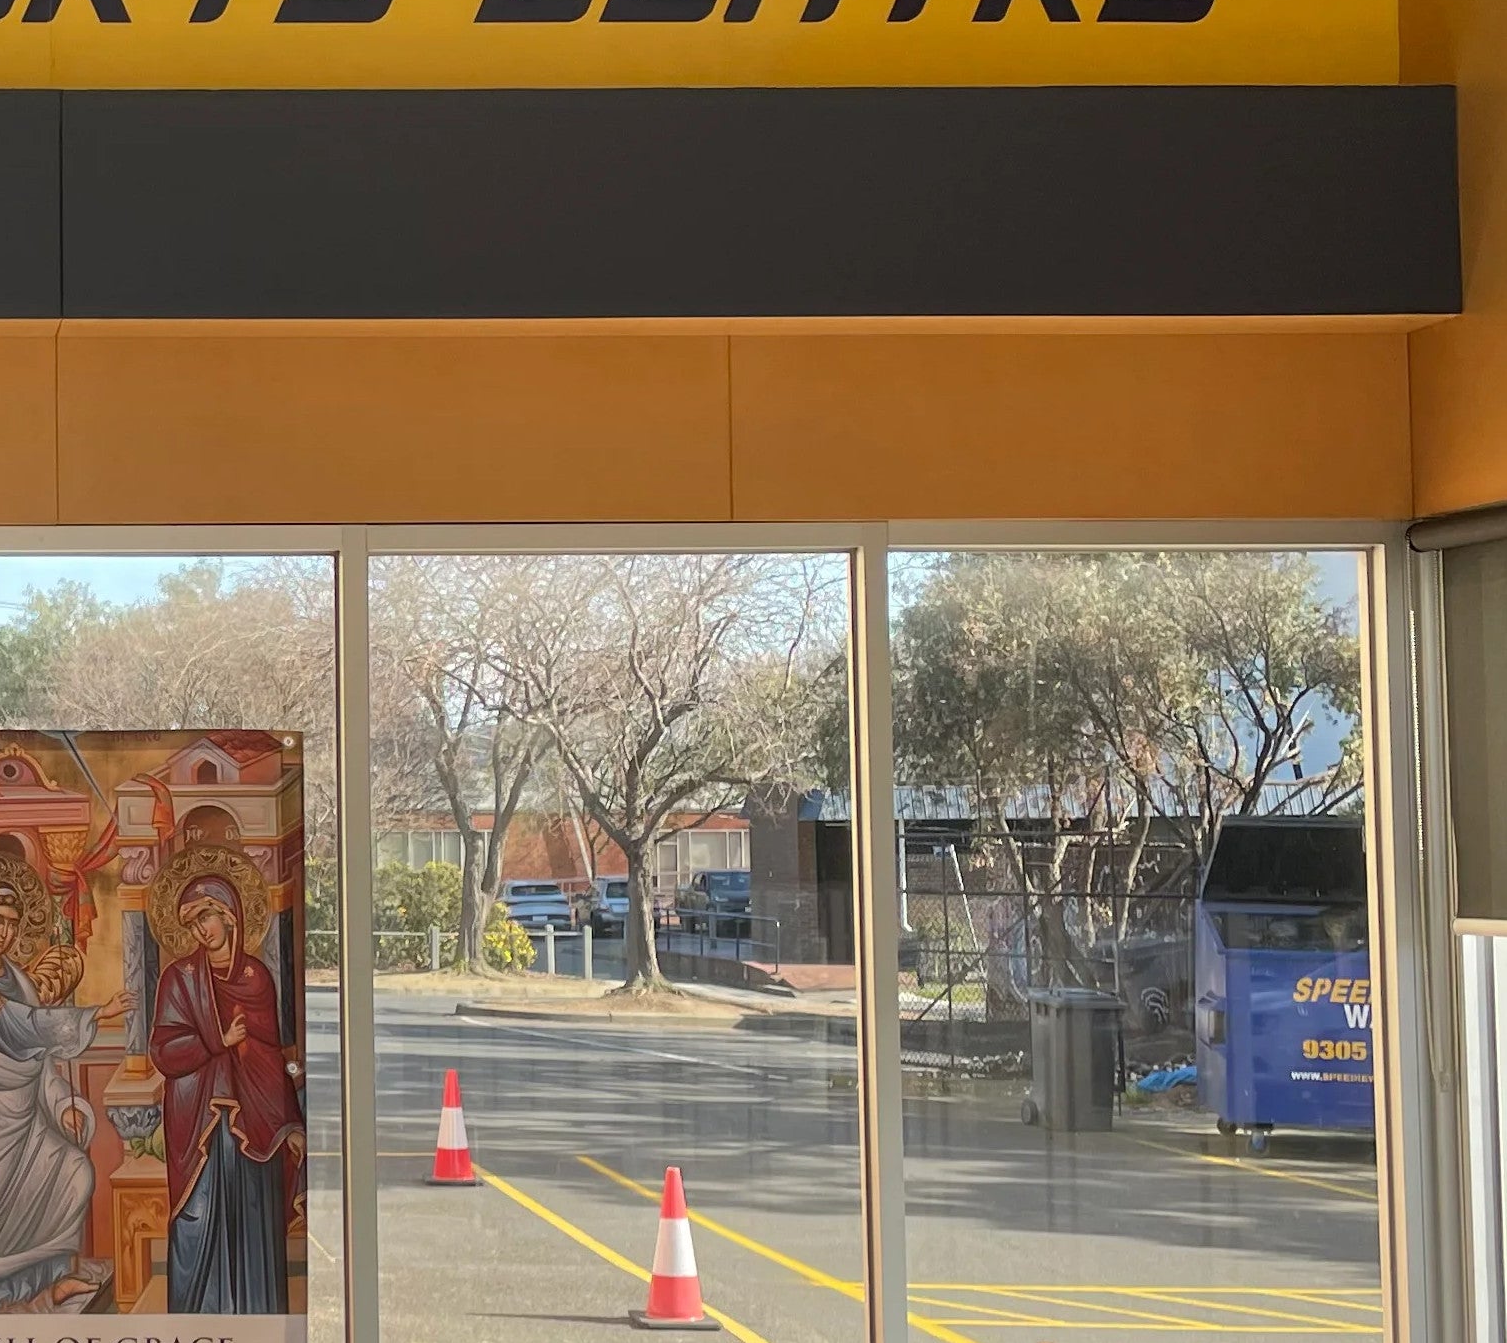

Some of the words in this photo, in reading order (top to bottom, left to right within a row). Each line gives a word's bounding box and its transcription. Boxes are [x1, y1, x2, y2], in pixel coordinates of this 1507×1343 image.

[1293, 977, 1372, 1004] SPEE
[1344, 1003, 1373, 1029] W
[1302, 1039, 1368, 1061] 9305
